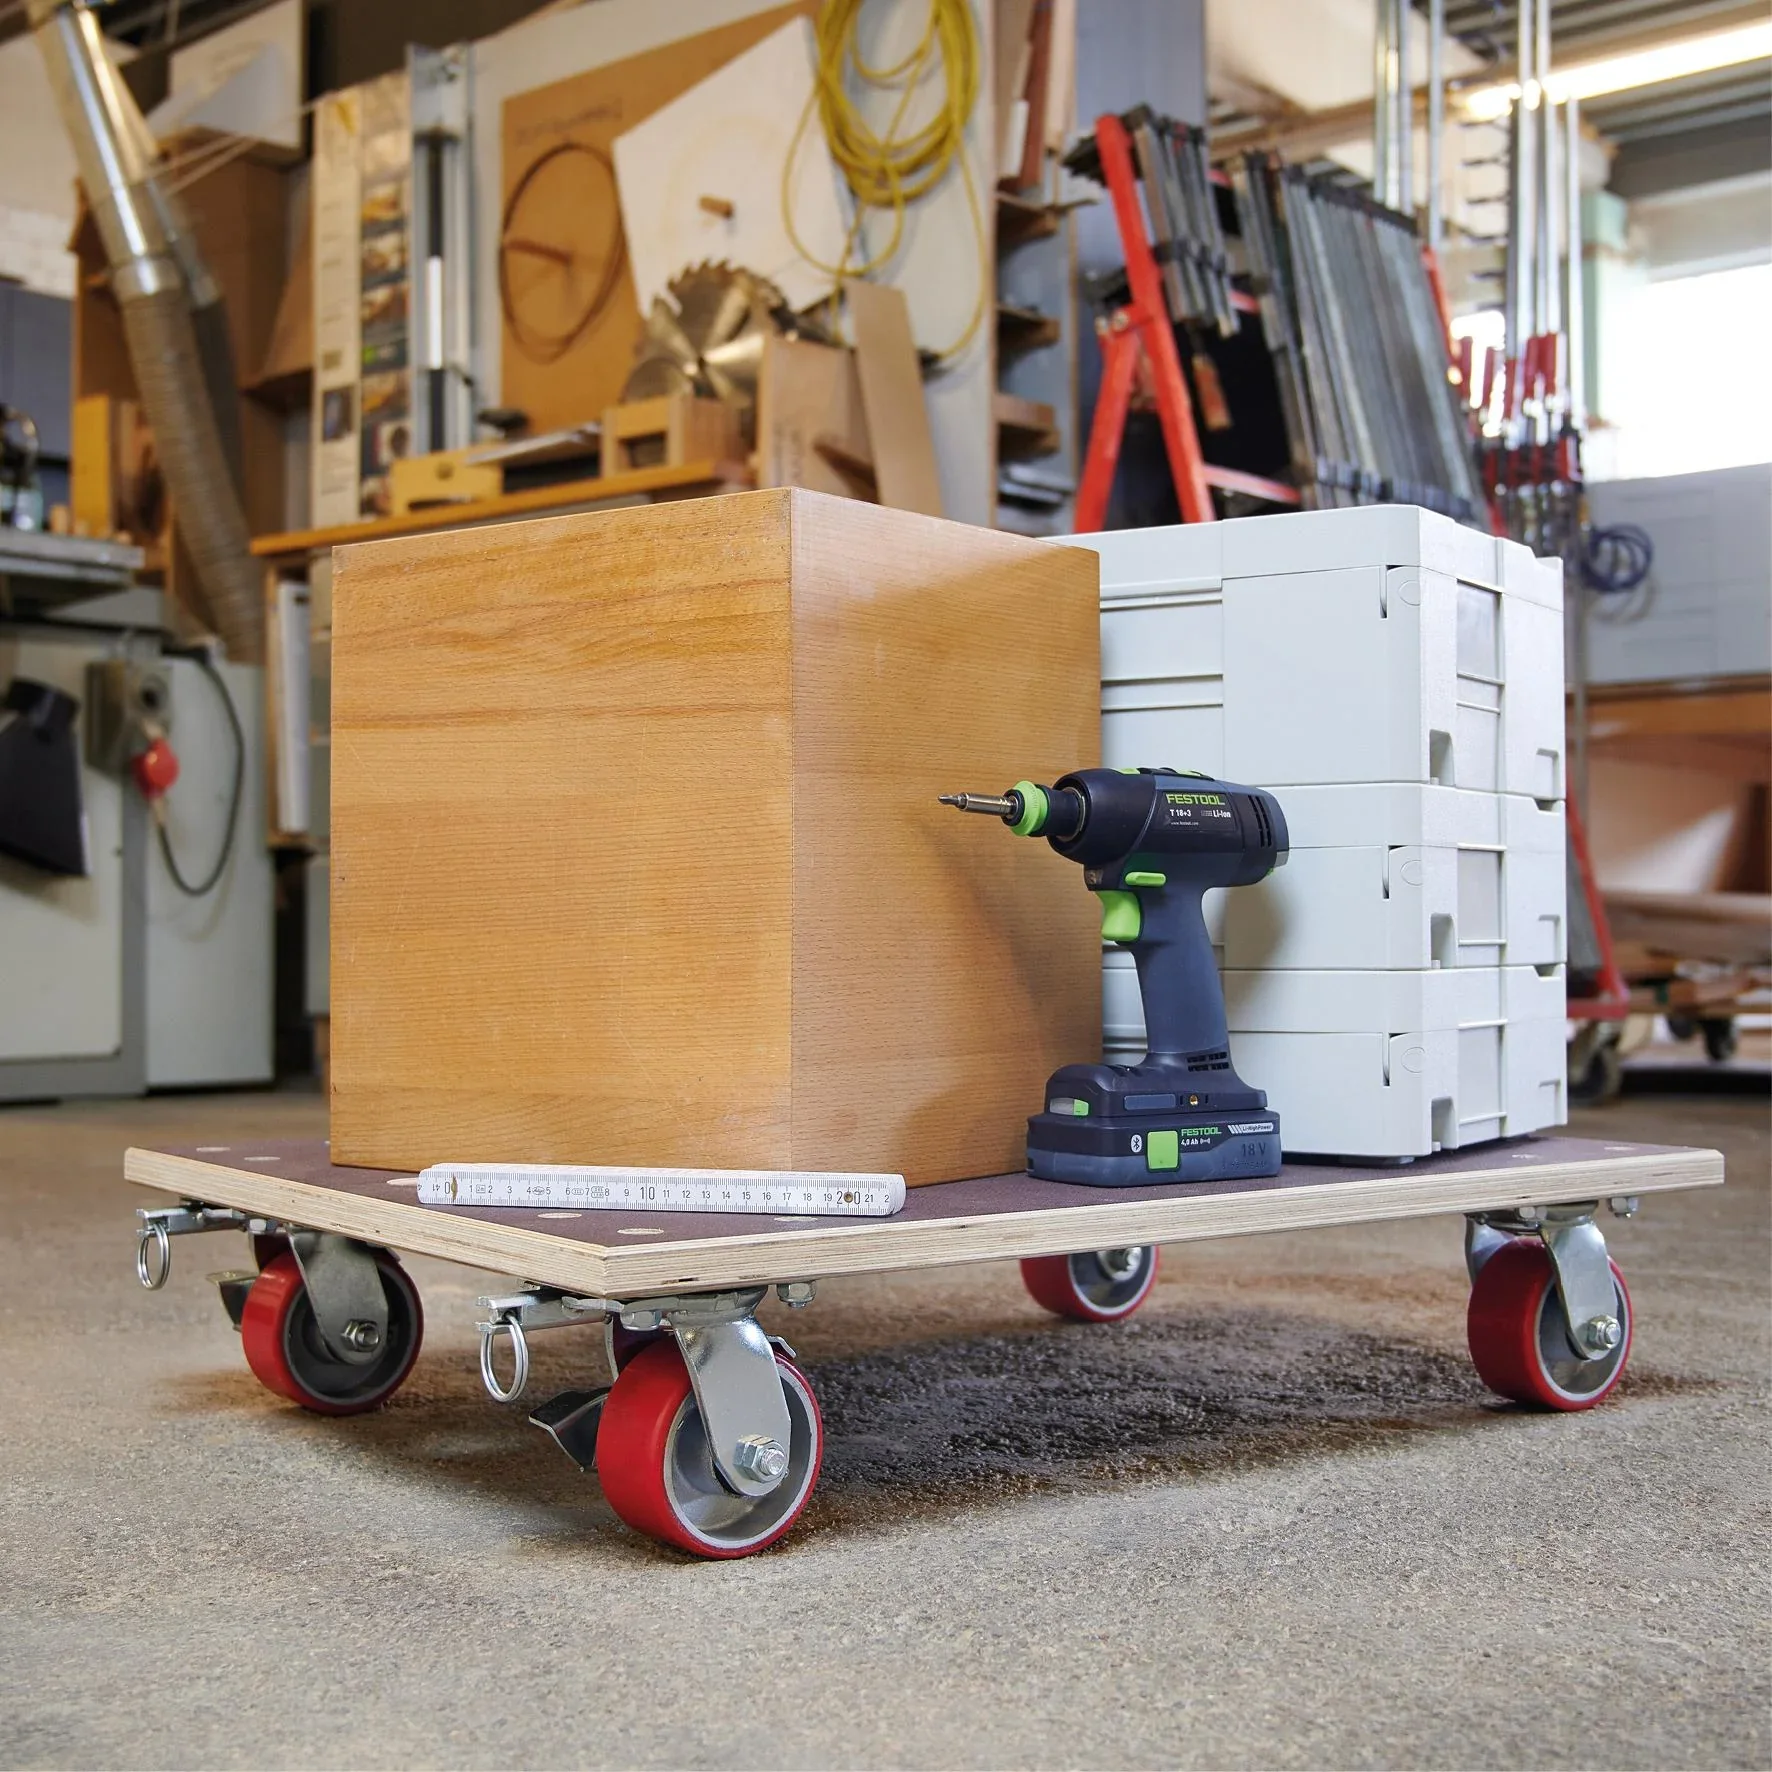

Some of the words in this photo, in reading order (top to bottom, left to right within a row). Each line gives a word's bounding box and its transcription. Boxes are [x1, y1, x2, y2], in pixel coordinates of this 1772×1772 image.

[1166, 794, 1226, 806] FESTOOL
[1169, 809, 1175, 817] T
[1176, 809, 1192, 817] 18+3
[1181, 1127, 1222, 1137] FESTOOL
[1241, 1143, 1256, 1157] 18
[1258, 1142, 1267, 1156] V
[469, 1184, 473, 1193] 1
[488, 1185, 493, 1194] 2
[507, 1186, 512, 1194] 3
[526, 1186, 531, 1194] 4
[546, 1187, 551, 1195] 5
[566, 1187, 570, 1196] 6
[585, 1187, 590, 1196] 7
[604, 1188, 610, 1196] 8
[624, 1188, 630, 1197] 9
[640, 1186, 655, 1200] 10
[663, 1189, 670, 1198] 11
[682, 1190, 691, 1199] 12
[702, 1190, 711, 1199] 13
[722, 1191, 731, 1200] 14
[742, 1191, 751, 1200] 15
[762, 1192, 772, 1200] 16
[783, 1192, 792, 1201] 17
[803, 1193, 812, 1201] 18
[824, 1193, 832, 1202] 19
[836, 1190, 860, 1204] 20
[864, 1194, 874, 1202] 21
